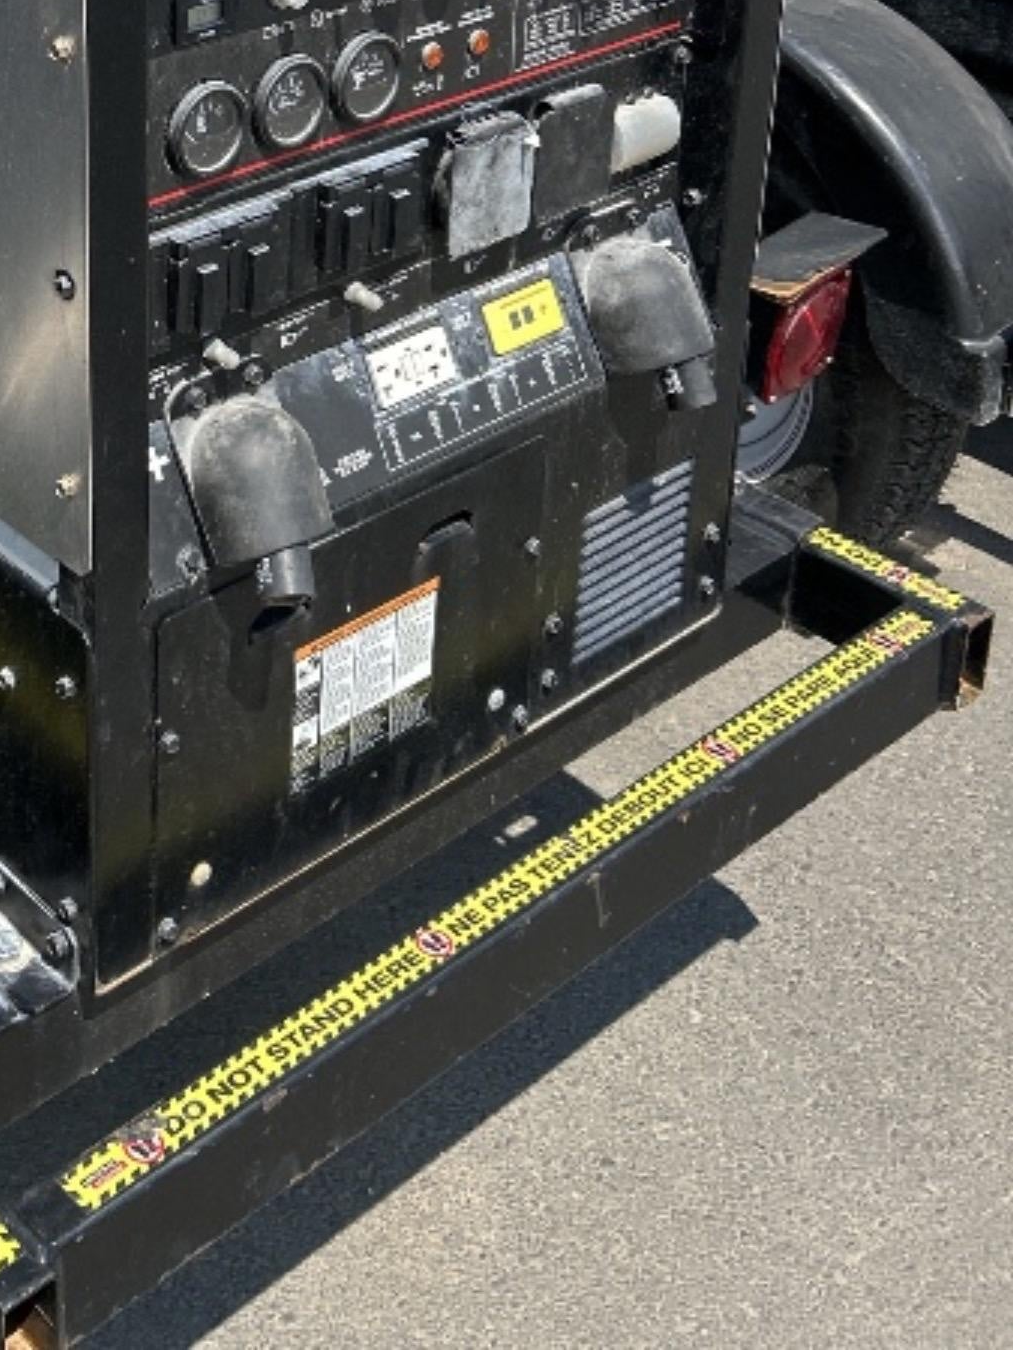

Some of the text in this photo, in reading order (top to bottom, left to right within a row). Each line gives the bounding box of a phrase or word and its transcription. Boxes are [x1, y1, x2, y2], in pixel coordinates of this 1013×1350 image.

[451, 907, 486, 938] NE
[482, 878, 531, 913] PAS
[595, 776, 681, 837] DEBOUT
[678, 756, 712, 782] ICI
[164, 951, 424, 1137] DO NOT STAND HERE
